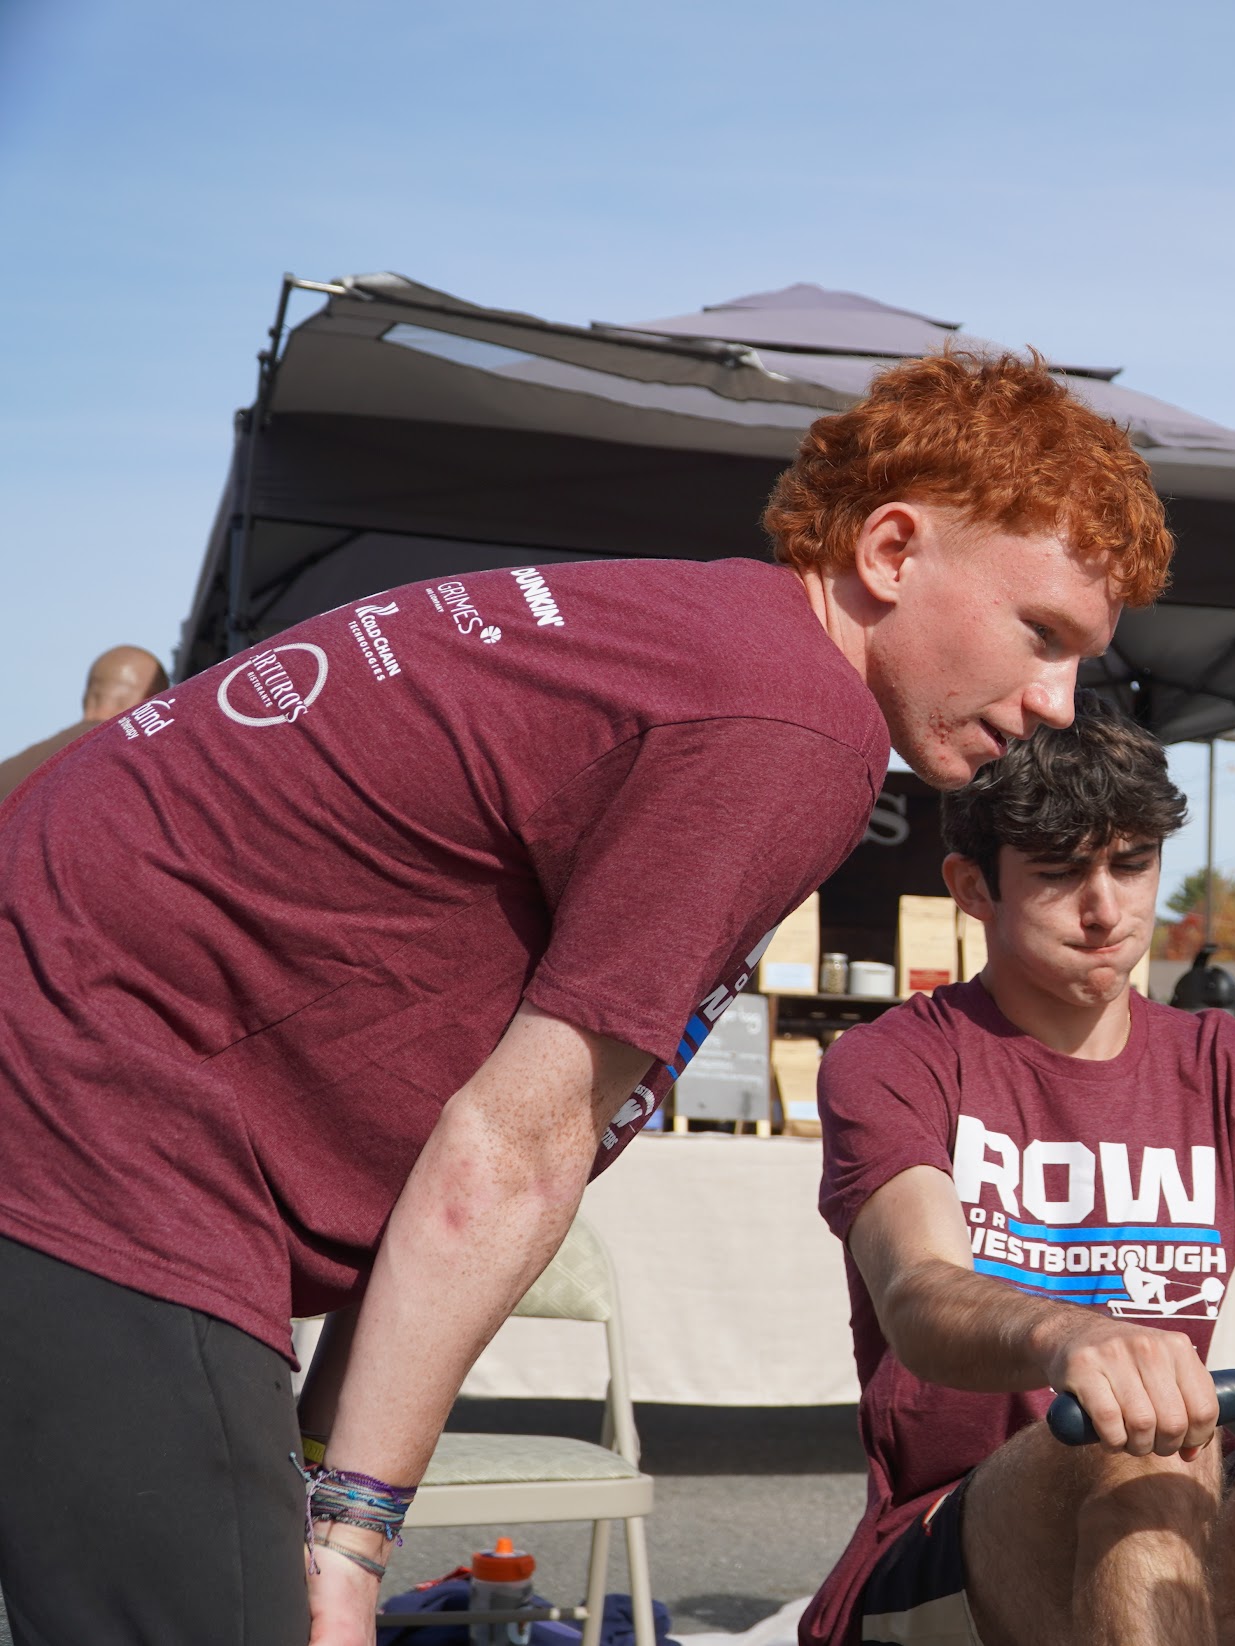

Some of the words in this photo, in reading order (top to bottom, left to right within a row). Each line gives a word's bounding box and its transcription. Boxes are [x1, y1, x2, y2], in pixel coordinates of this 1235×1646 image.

[437, 581, 483, 635] GRIMES
[510, 567, 565, 627] DUNKIN'
[348, 620, 386, 682] TECHNOLOGIES
[360, 614, 382, 638] COLD
[373, 637, 402, 677] CHAIN
[246, 671, 274, 708] RISTORANTE
[249, 648, 310, 724] ARTURO'S
[953, 1114, 1216, 1226] ROW
[969, 1207, 1006, 1230] OR
